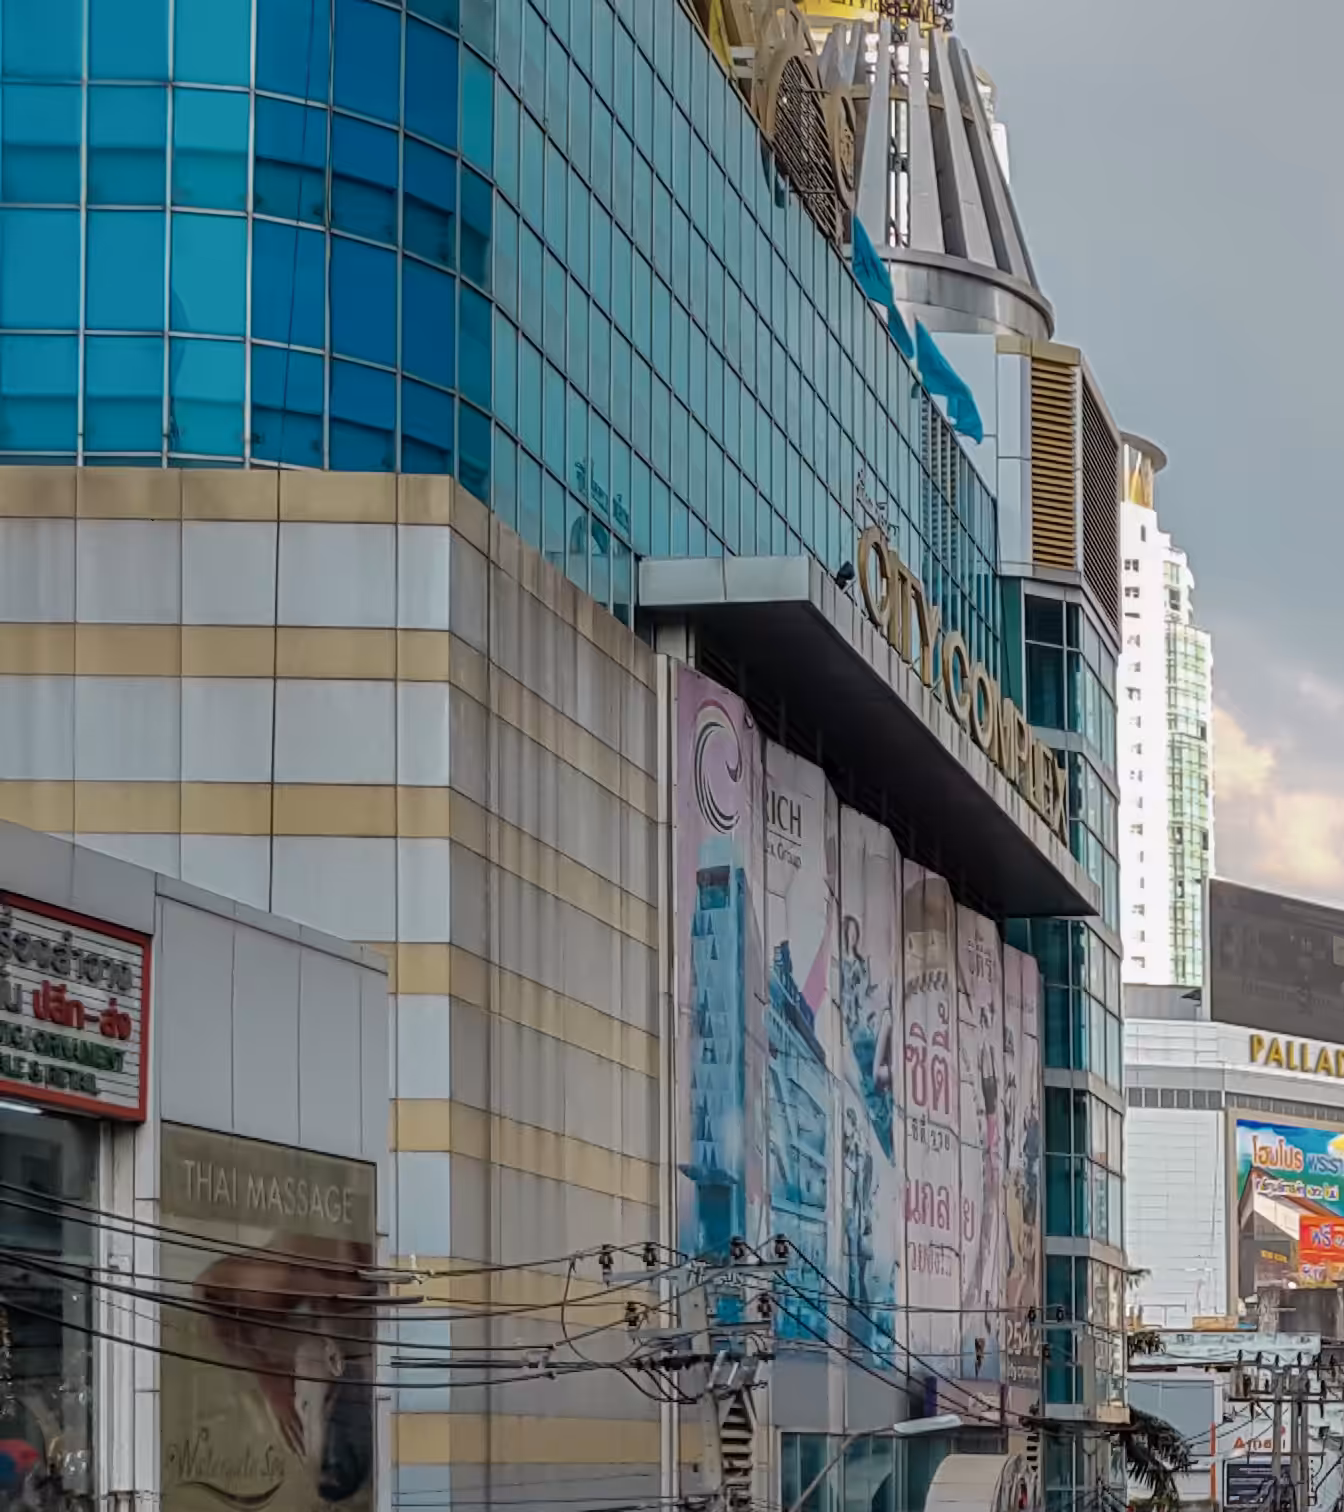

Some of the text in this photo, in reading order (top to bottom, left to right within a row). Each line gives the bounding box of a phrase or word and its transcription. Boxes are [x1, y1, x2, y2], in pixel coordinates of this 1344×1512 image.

[858, 526, 941, 688] CITY
[766, 790, 802, 838] ICH
[184, 1160, 354, 1224] THAI MASSAGE
